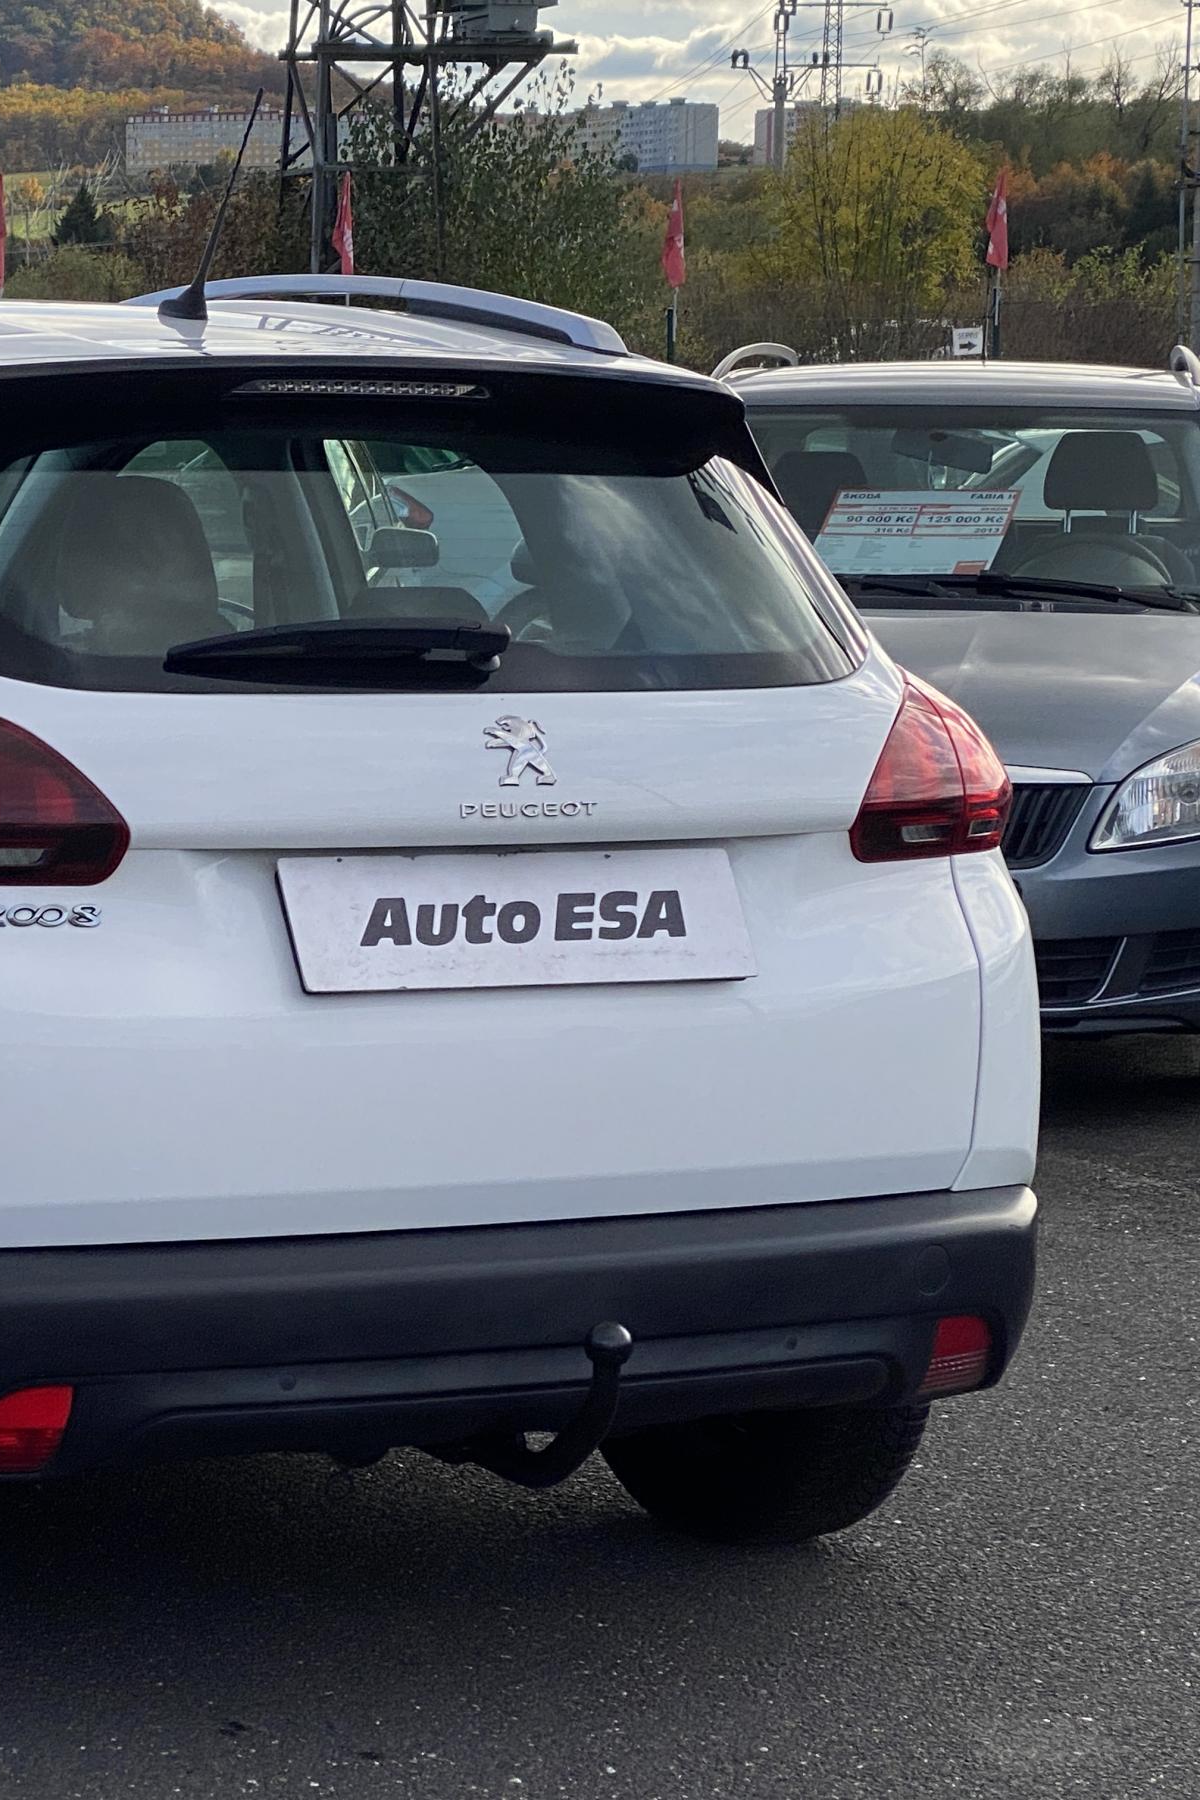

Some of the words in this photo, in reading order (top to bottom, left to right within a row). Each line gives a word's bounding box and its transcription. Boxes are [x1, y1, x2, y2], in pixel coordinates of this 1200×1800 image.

[846, 515, 863, 523] 90
[866, 515, 892, 523] 000
[927, 515, 952, 523] 125
[955, 515, 981, 523] 000
[460, 800, 598, 819] PEUGEOT
[360, 894, 541, 947] Auto
[554, 890, 687, 941] ESA
